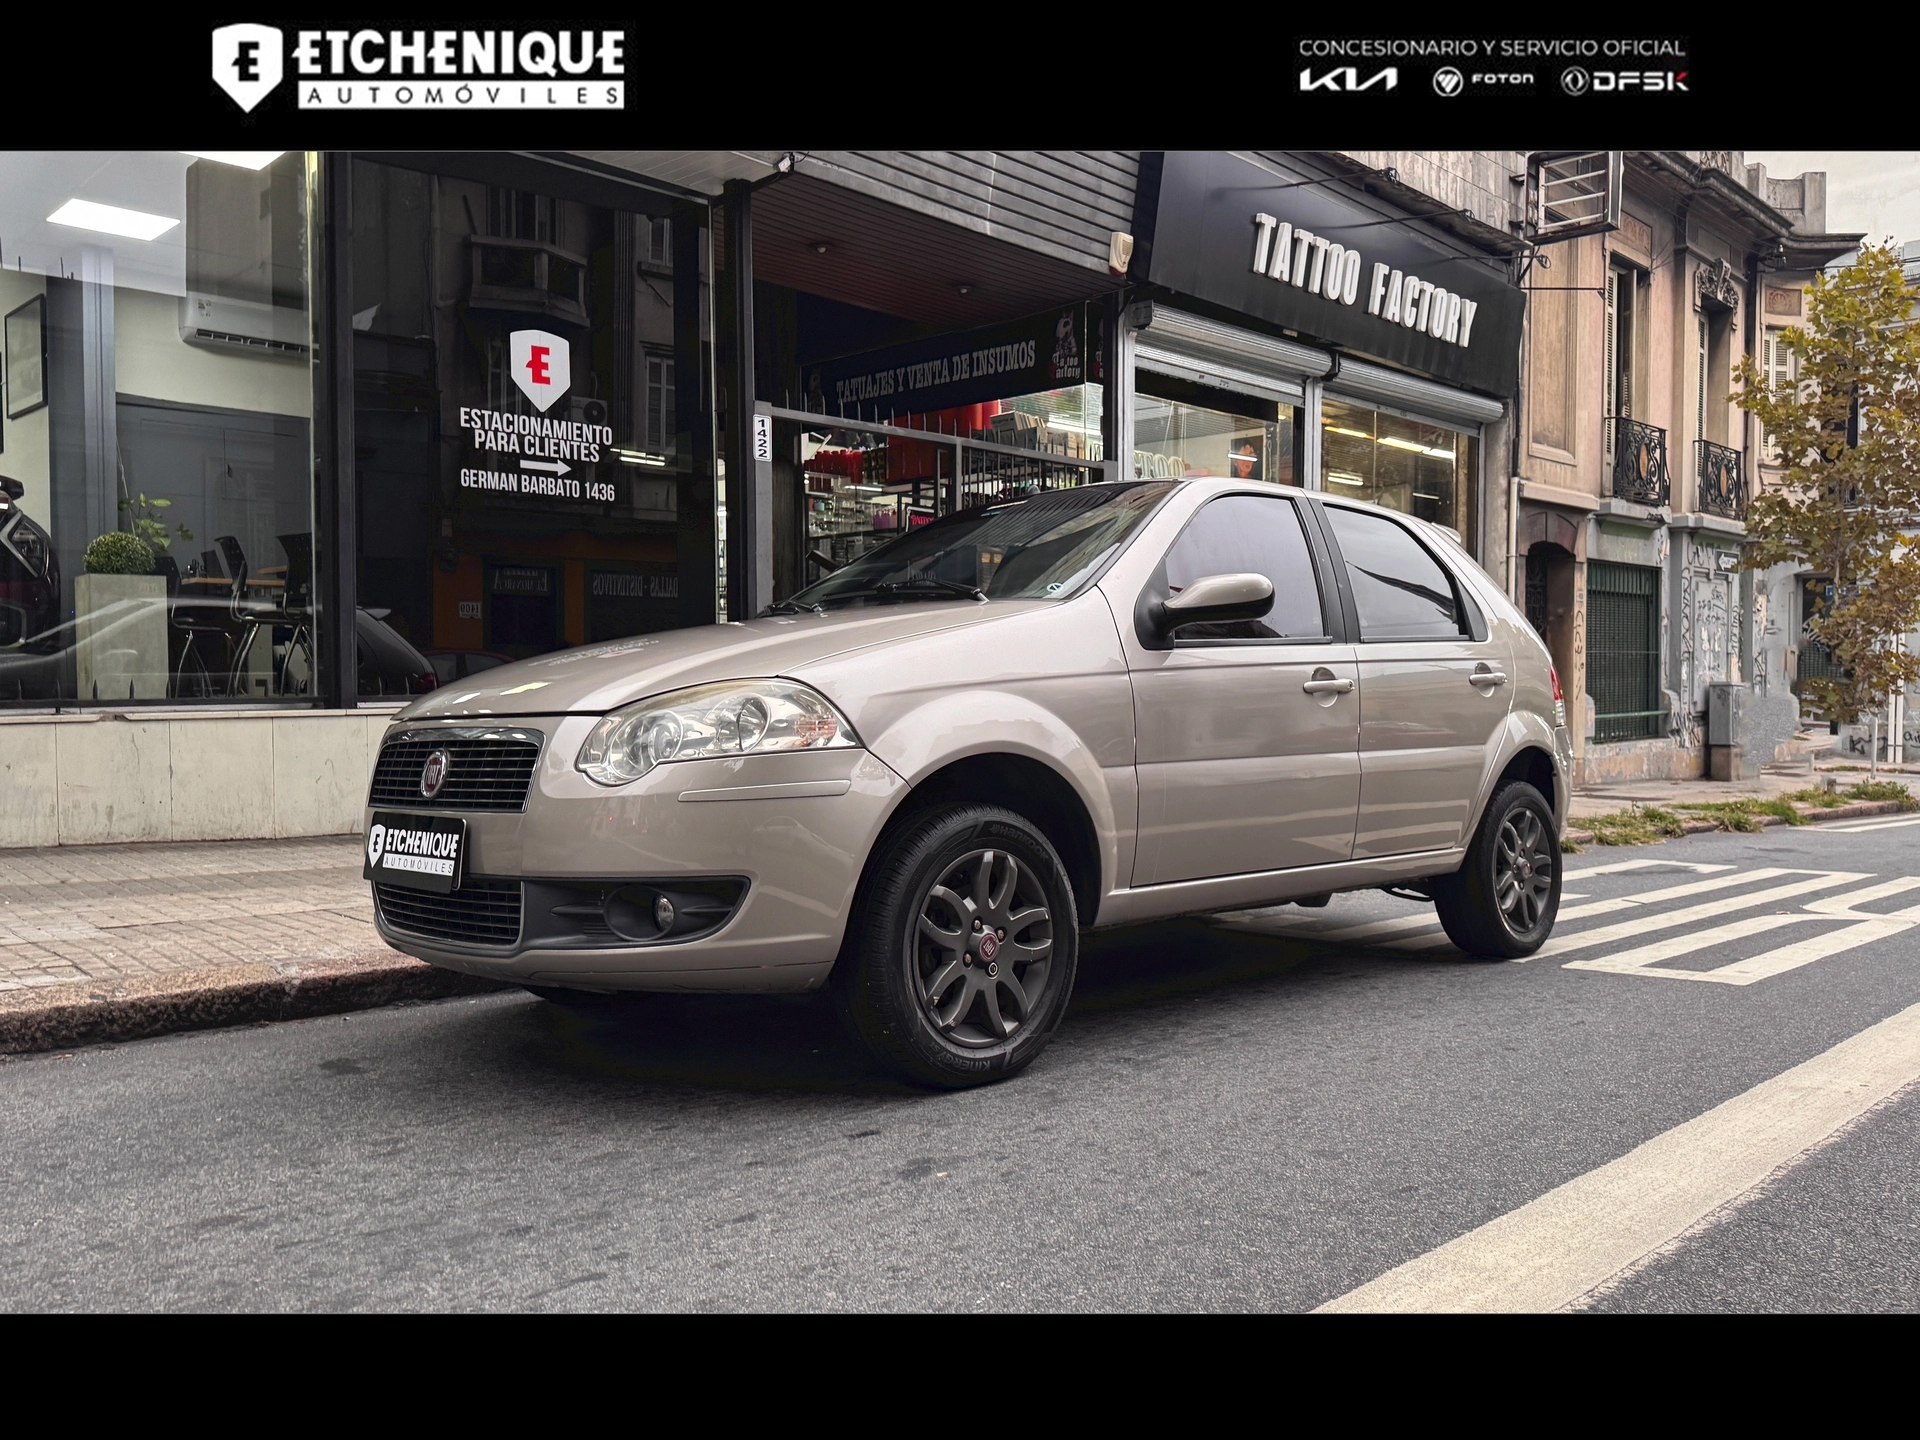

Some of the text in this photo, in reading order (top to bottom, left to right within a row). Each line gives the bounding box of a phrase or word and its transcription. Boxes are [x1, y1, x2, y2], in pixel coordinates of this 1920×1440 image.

[1253, 212, 1478, 348] TATTOO FACTORY
[836, 339, 1036, 405] TATUAJES Y VENTA DE INSUMOS
[460, 406, 613, 446] ESTACIONAMIENTO
[757, 418, 768, 459] 1422
[474, 428, 600, 463] PARA CLIENTES
[460, 468, 615, 502] GERMAN BARBATO 1436
[385, 828, 459, 858] ETCHENIQUE
[384, 857, 453, 875] AUTOMÓVILES
